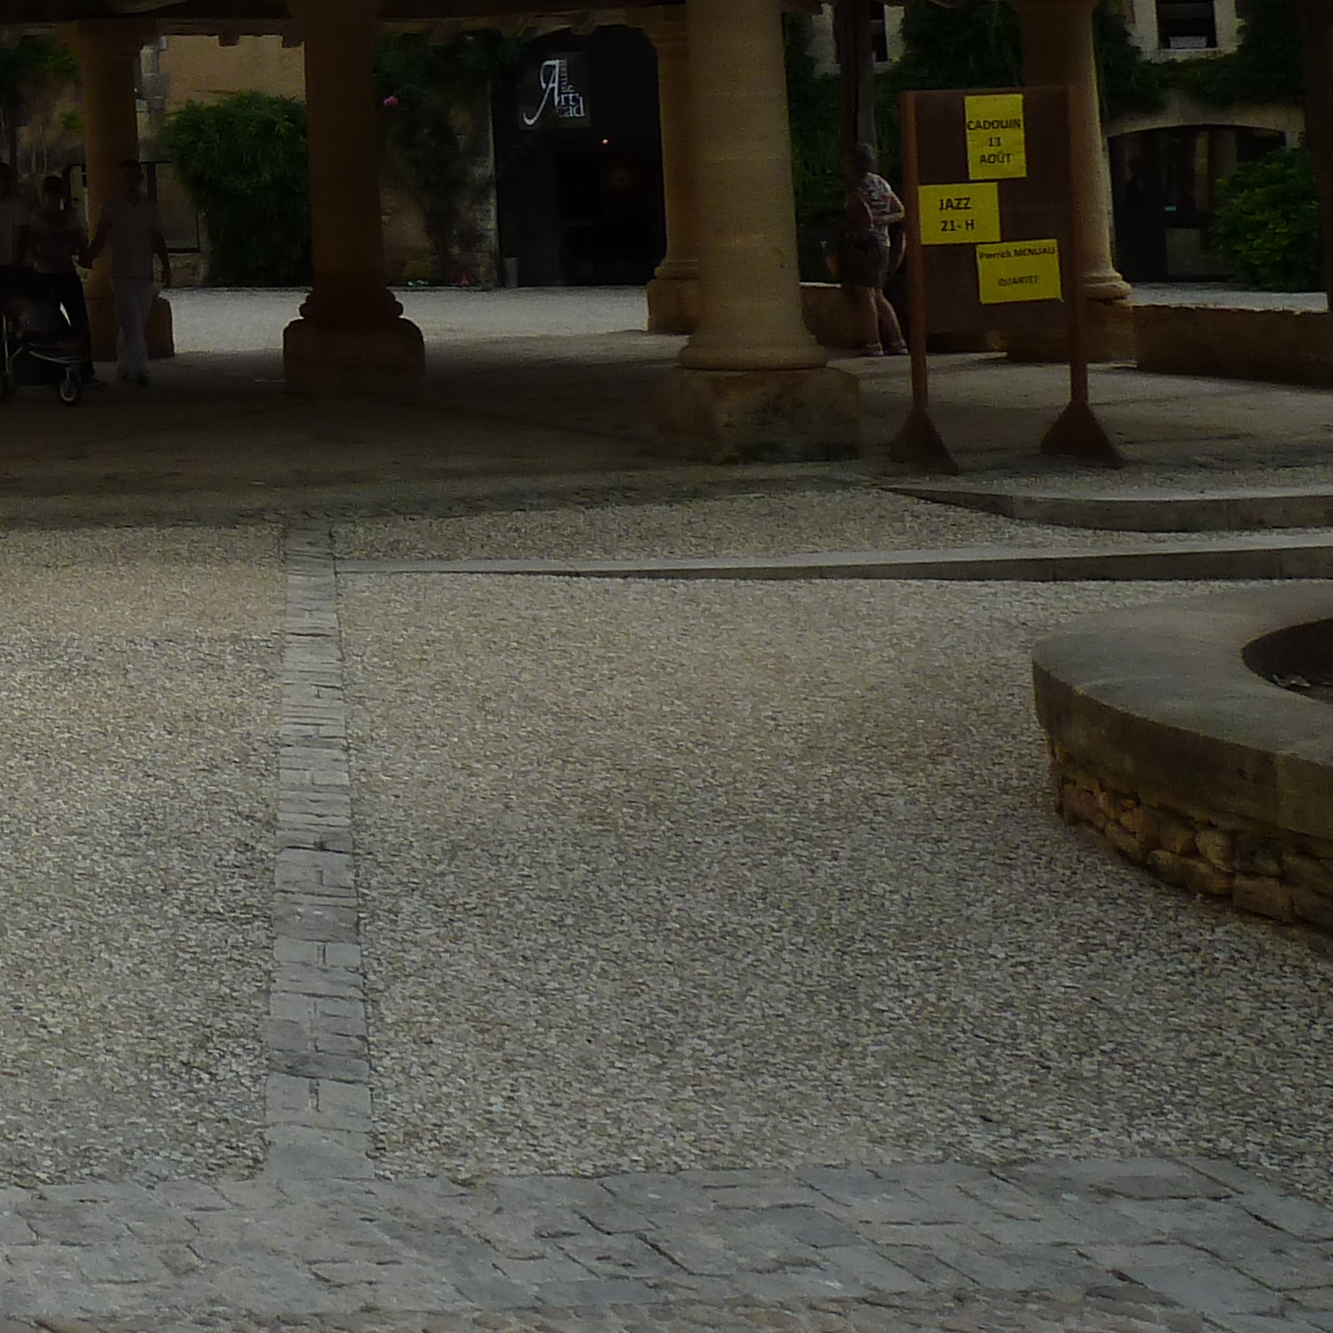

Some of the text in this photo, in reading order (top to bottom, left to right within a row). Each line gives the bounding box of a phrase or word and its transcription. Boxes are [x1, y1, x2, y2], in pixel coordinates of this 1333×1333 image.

[967, 119, 1021, 130] CADOUIN
[988, 137, 1002, 147] 13
[939, 197, 972, 211] JAZZ
